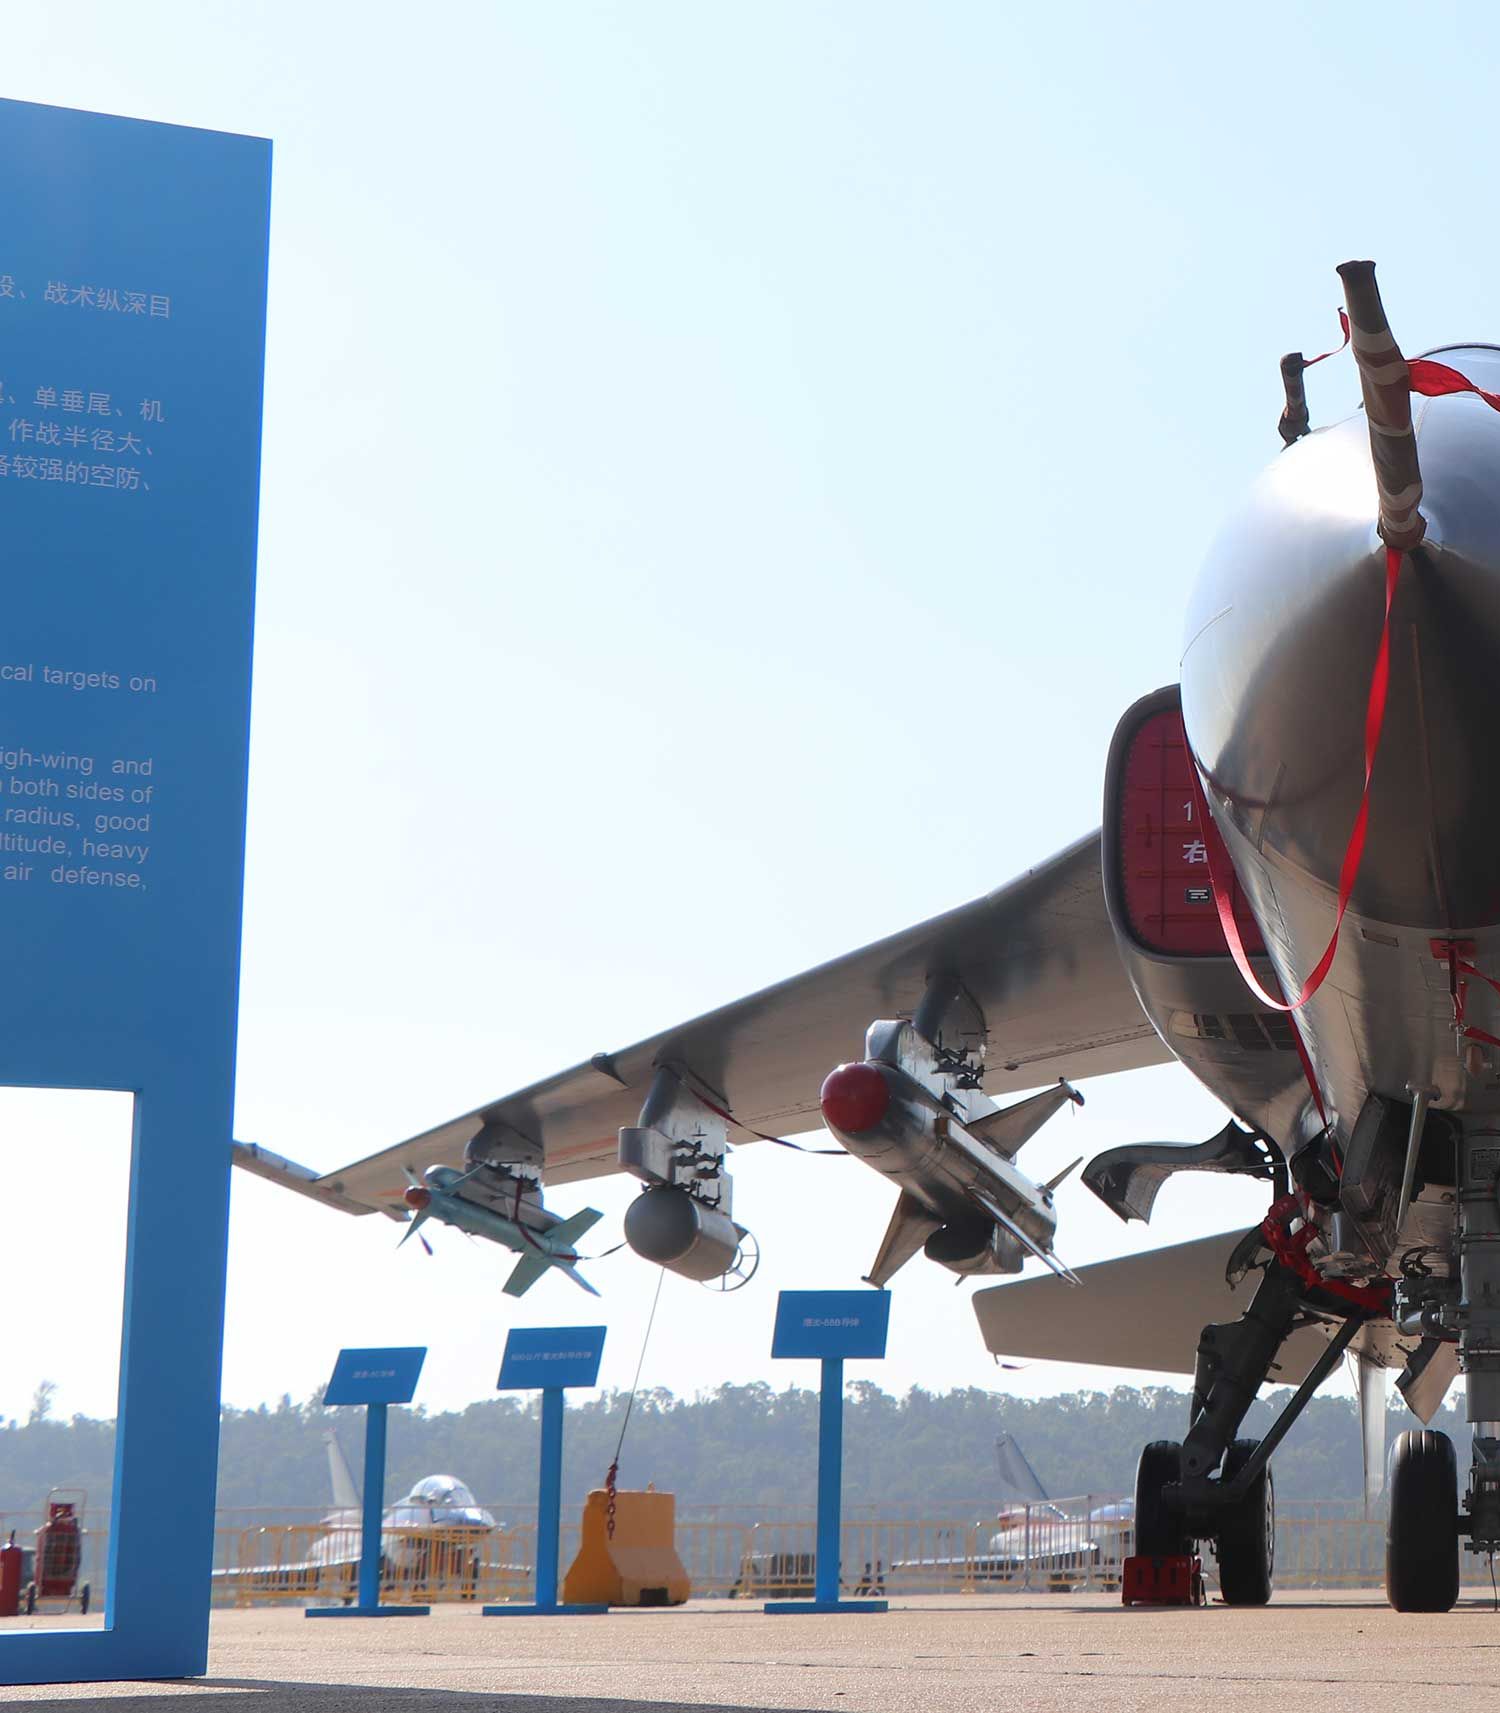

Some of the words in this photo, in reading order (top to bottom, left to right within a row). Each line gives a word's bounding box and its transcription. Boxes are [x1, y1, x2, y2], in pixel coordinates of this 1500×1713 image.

[0, 381, 165, 422] 、单垂尾、机
[43, 665, 120, 691] targets
[129, 676, 157, 693] on
[111, 758, 153, 776] and
[10, 776, 59, 797] both
[66, 781, 125, 802] sides
[131, 785, 153, 804] of
[5, 806, 80, 829] radius,
[95, 813, 151, 833] good
[82, 838, 150, 864] heavy
[1182, 839, 1208, 864] 右
[4, 862, 33, 881] air
[51, 865, 147, 890] defense,
